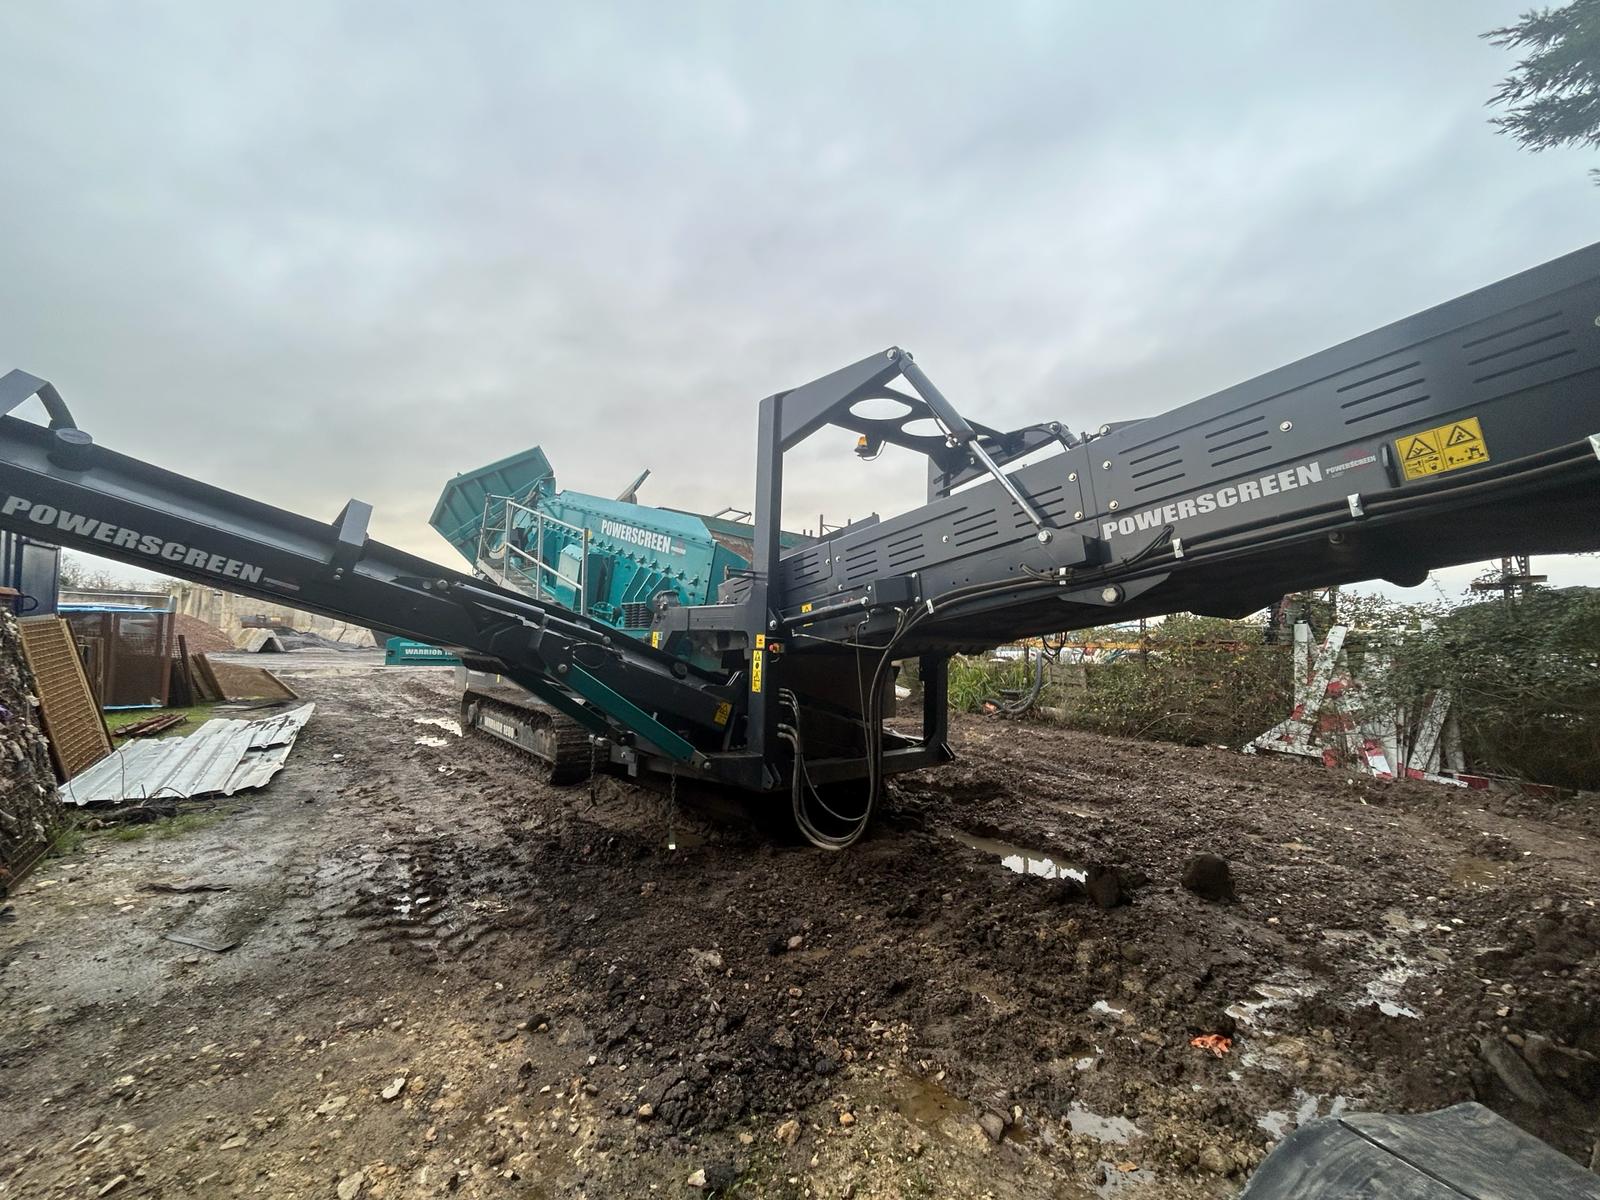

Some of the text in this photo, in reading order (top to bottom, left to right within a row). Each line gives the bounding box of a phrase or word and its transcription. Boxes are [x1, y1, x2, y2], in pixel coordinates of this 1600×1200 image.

[1, 495, 263, 583] POWERSCREEN
[601, 519, 671, 553] POWERSCREEN
[1102, 461, 1322, 540] POWERSCREEN
